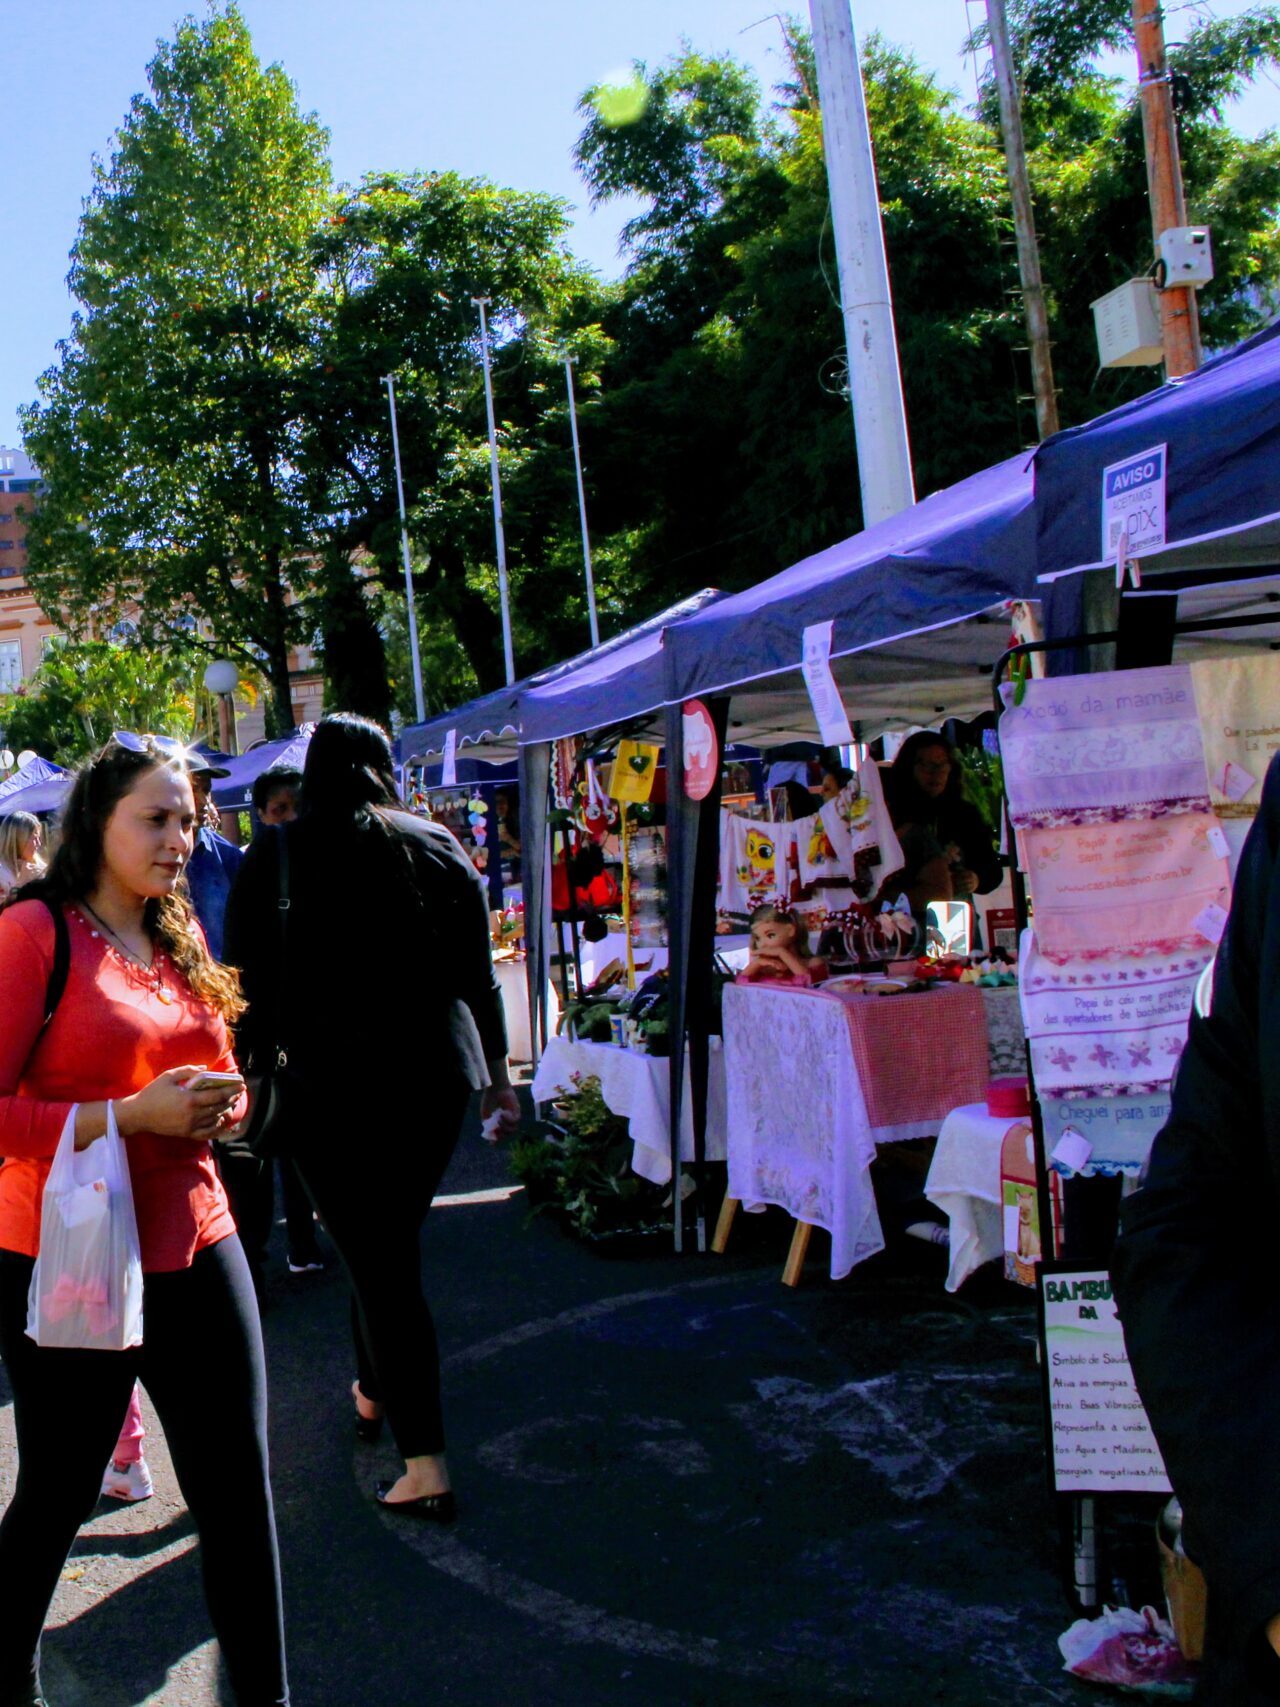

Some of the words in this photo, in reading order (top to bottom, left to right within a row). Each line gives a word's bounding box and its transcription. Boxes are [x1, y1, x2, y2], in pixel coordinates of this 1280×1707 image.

[1112, 462, 1154, 491] AVISO
[1113, 488, 1152, 510] ACEITAMOS
[1127, 506, 1157, 538] pix
[1080, 696, 1104, 713] da
[1116, 688, 1186, 710] mamãe
[1075, 997, 1098, 1010] Papai
[1103, 996, 1113, 1006] do
[1118, 993, 1134, 1005] céu
[1139, 994, 1152, 1003] me
[1120, 1009, 1131, 1019] de
[1058, 1103, 1108, 1124] Cheguei
[1115, 1107, 1144, 1124] para
[1079, 1306, 1098, 1320] DA
[1088, 1353, 1100, 1364] de
[1054, 1421, 1105, 1435] Representa
[1055, 1468, 1093, 1479] energias
